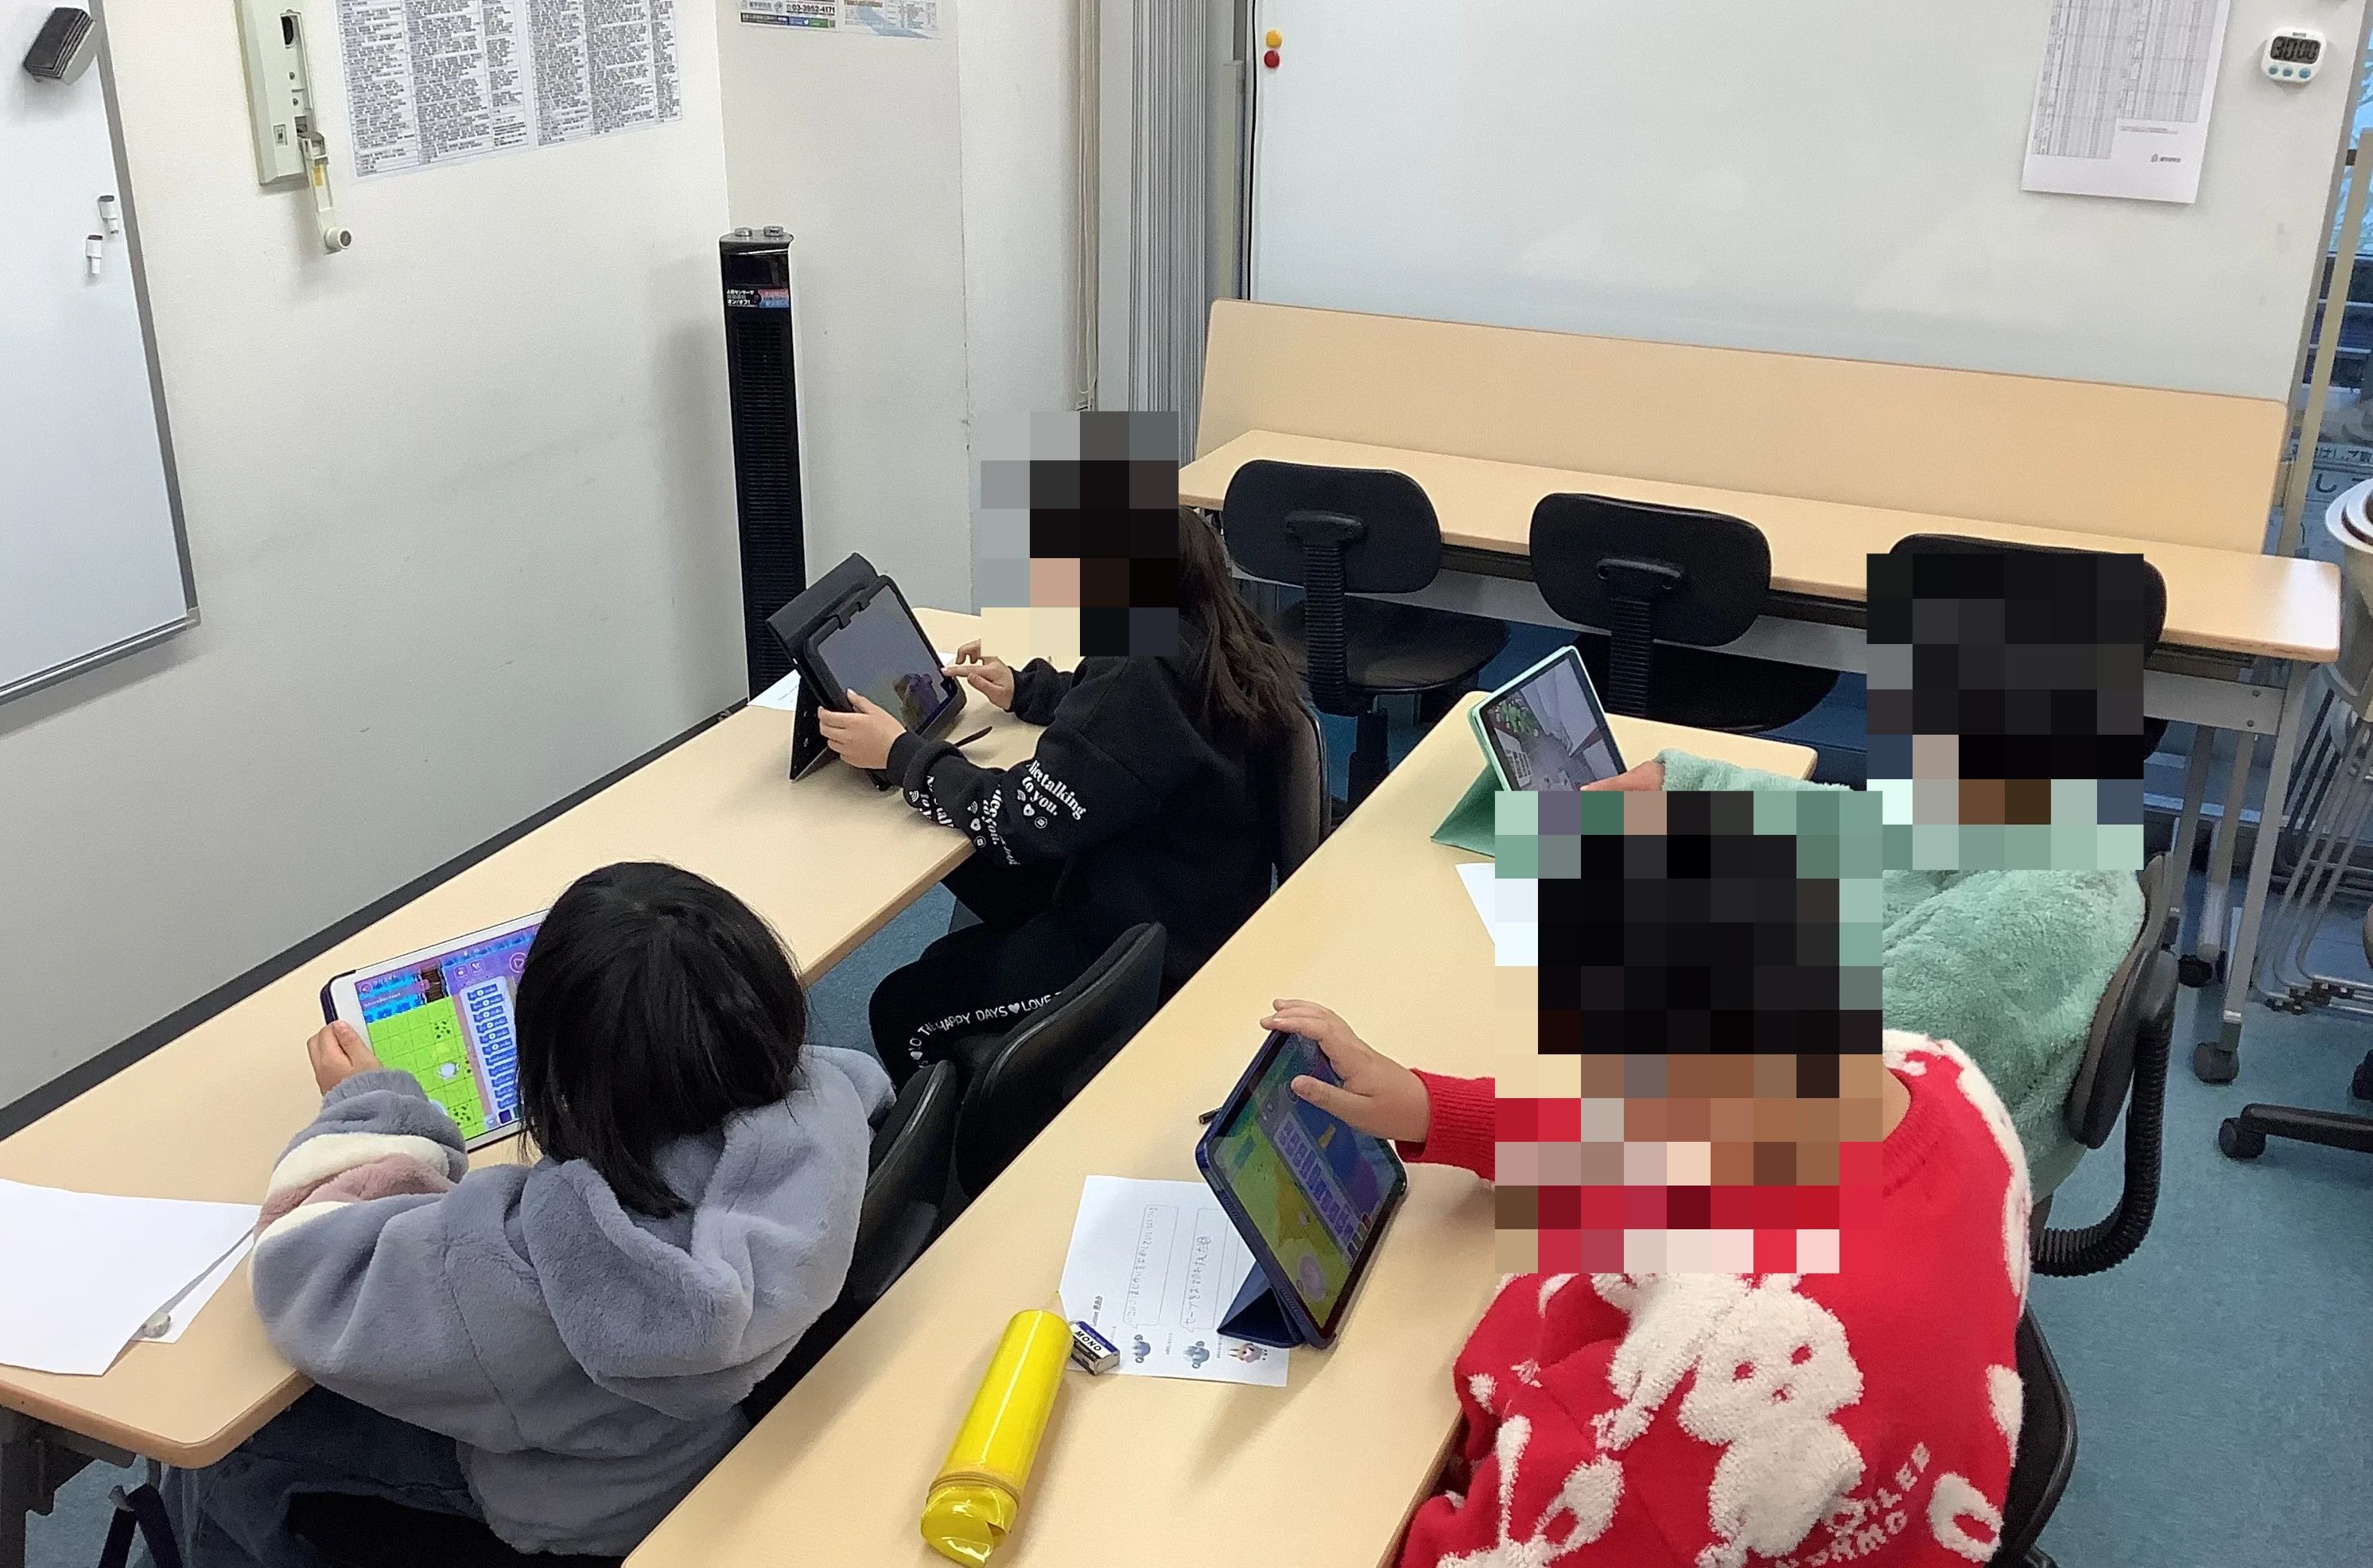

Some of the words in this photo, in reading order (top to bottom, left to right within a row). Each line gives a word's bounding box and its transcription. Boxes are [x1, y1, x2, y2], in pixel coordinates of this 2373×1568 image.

[1022, 776, 1034, 793] to
[1030, 789, 1058, 816] you.
[1039, 776, 1086, 821] talking
[936, 1013, 970, 1030] HAPPY
[976, 1006, 1008, 1021] DAYS
[1074, 1331, 1101, 1352] MONO
